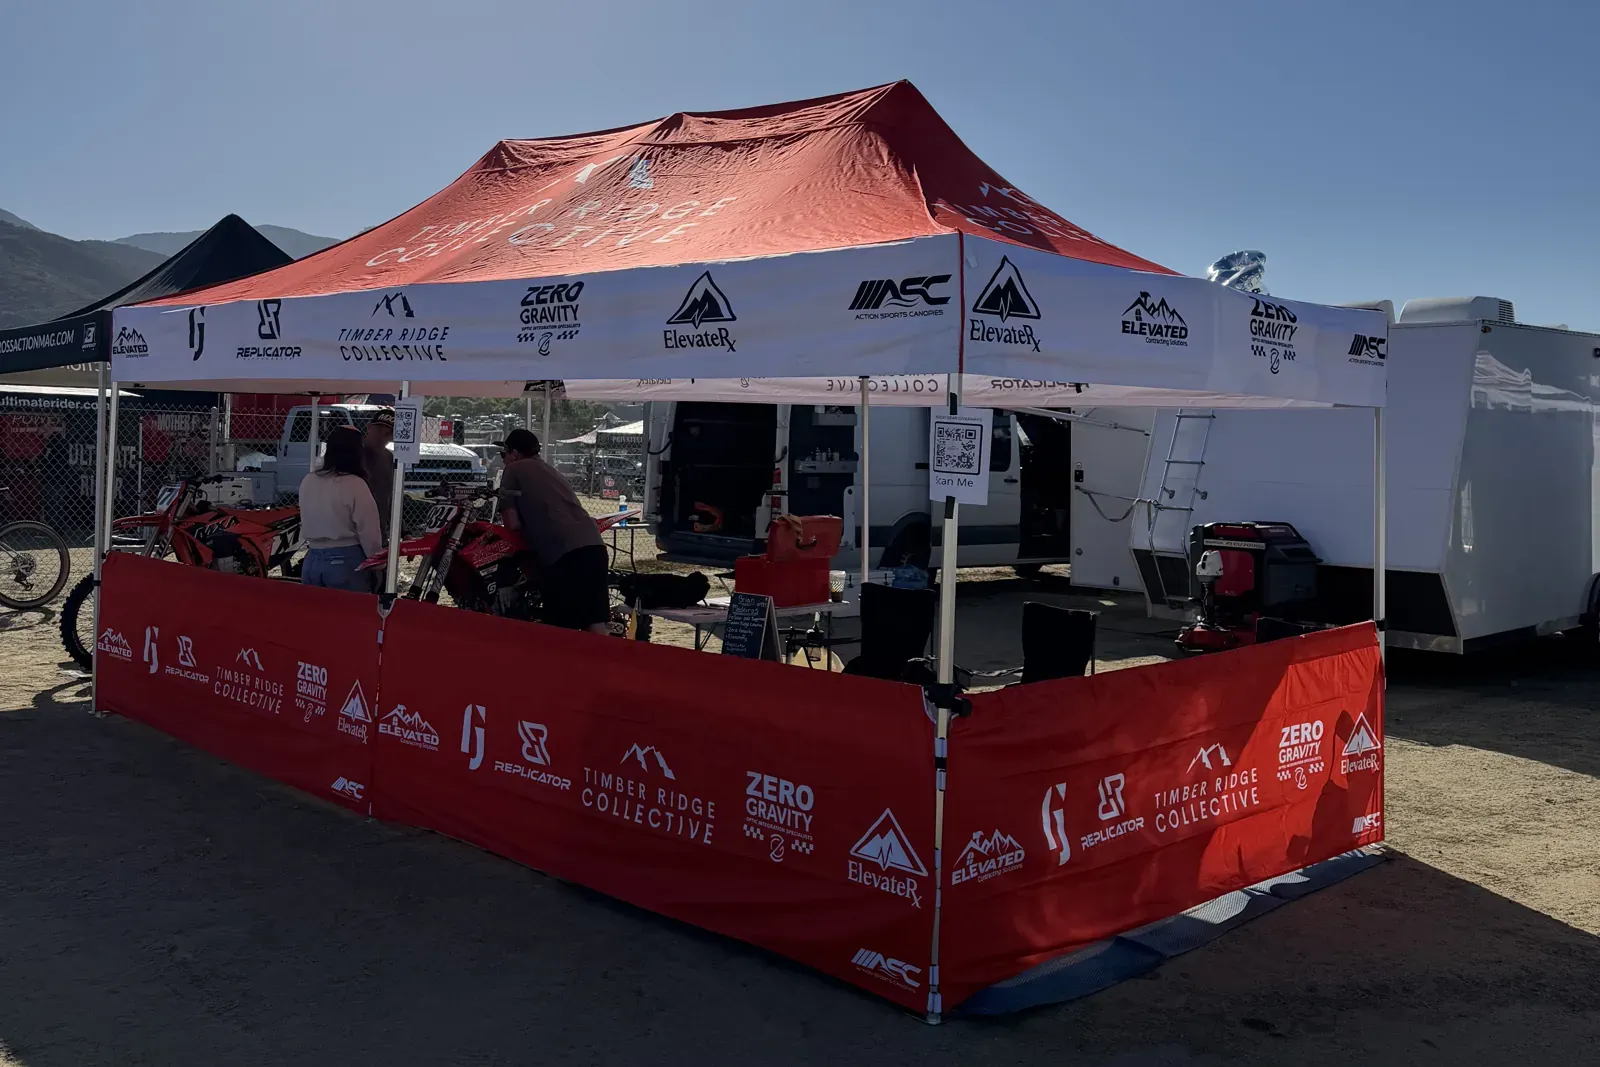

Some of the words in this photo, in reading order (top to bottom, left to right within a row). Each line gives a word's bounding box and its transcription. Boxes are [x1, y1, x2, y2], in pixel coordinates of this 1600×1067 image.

[568, 197, 738, 222] RIDGE
[521, 281, 585, 306] ZERO
[520, 304, 579, 325] GRAVITY
[880, 311, 908, 319] SPORTS
[909, 309, 944, 317] CANOPIES
[338, 328, 393, 341] TIMBER
[401, 327, 449, 341] RIDGE
[664, 327, 736, 352] ElevateRx
[970, 319, 1041, 352] ElevateRx
[1122, 320, 1188, 339] ELEVATED
[1250, 319, 1298, 341] GRAVITY
[113, 344, 148, 354] ELEVATED
[236, 346, 302, 359] REPLICATOR
[340, 345, 447, 361] COLLECTIVE
[957, 478, 974, 487] Me
[97, 641, 132, 658] ELEVATED
[165, 665, 210, 684] REPLICATOR
[216, 666, 251, 686] TIMBER
[255, 676, 284, 697] RIDGE
[297, 661, 328, 686] ZERO
[214, 682, 282, 715] COLLECTIVE
[297, 679, 327, 700] GRAVITY
[337, 716, 369, 745] ElevateRx
[378, 723, 440, 746] ELEVATED
[1279, 720, 1324, 748] ZERO
[1278, 740, 1321, 764] GRAVITY
[1341, 753, 1380, 775] ElevateRx
[494, 760, 572, 790] REPLICATOR
[583, 767, 646, 800] TIMBER
[658, 786, 715, 820] RIDGE
[746, 771, 814, 811] ZERO
[1155, 781, 1207, 809] TIMBER
[1215, 767, 1258, 793] RIDGE
[582, 788, 714, 845] COLLECTIVE
[746, 798, 813, 832] GRAVITY
[1155, 786, 1259, 833] COLLECTIVE
[1080, 817, 1144, 851] REPLICATOR
[952, 850, 1025, 885] ELEVATED
[848, 860, 922, 909] ElevateRx
